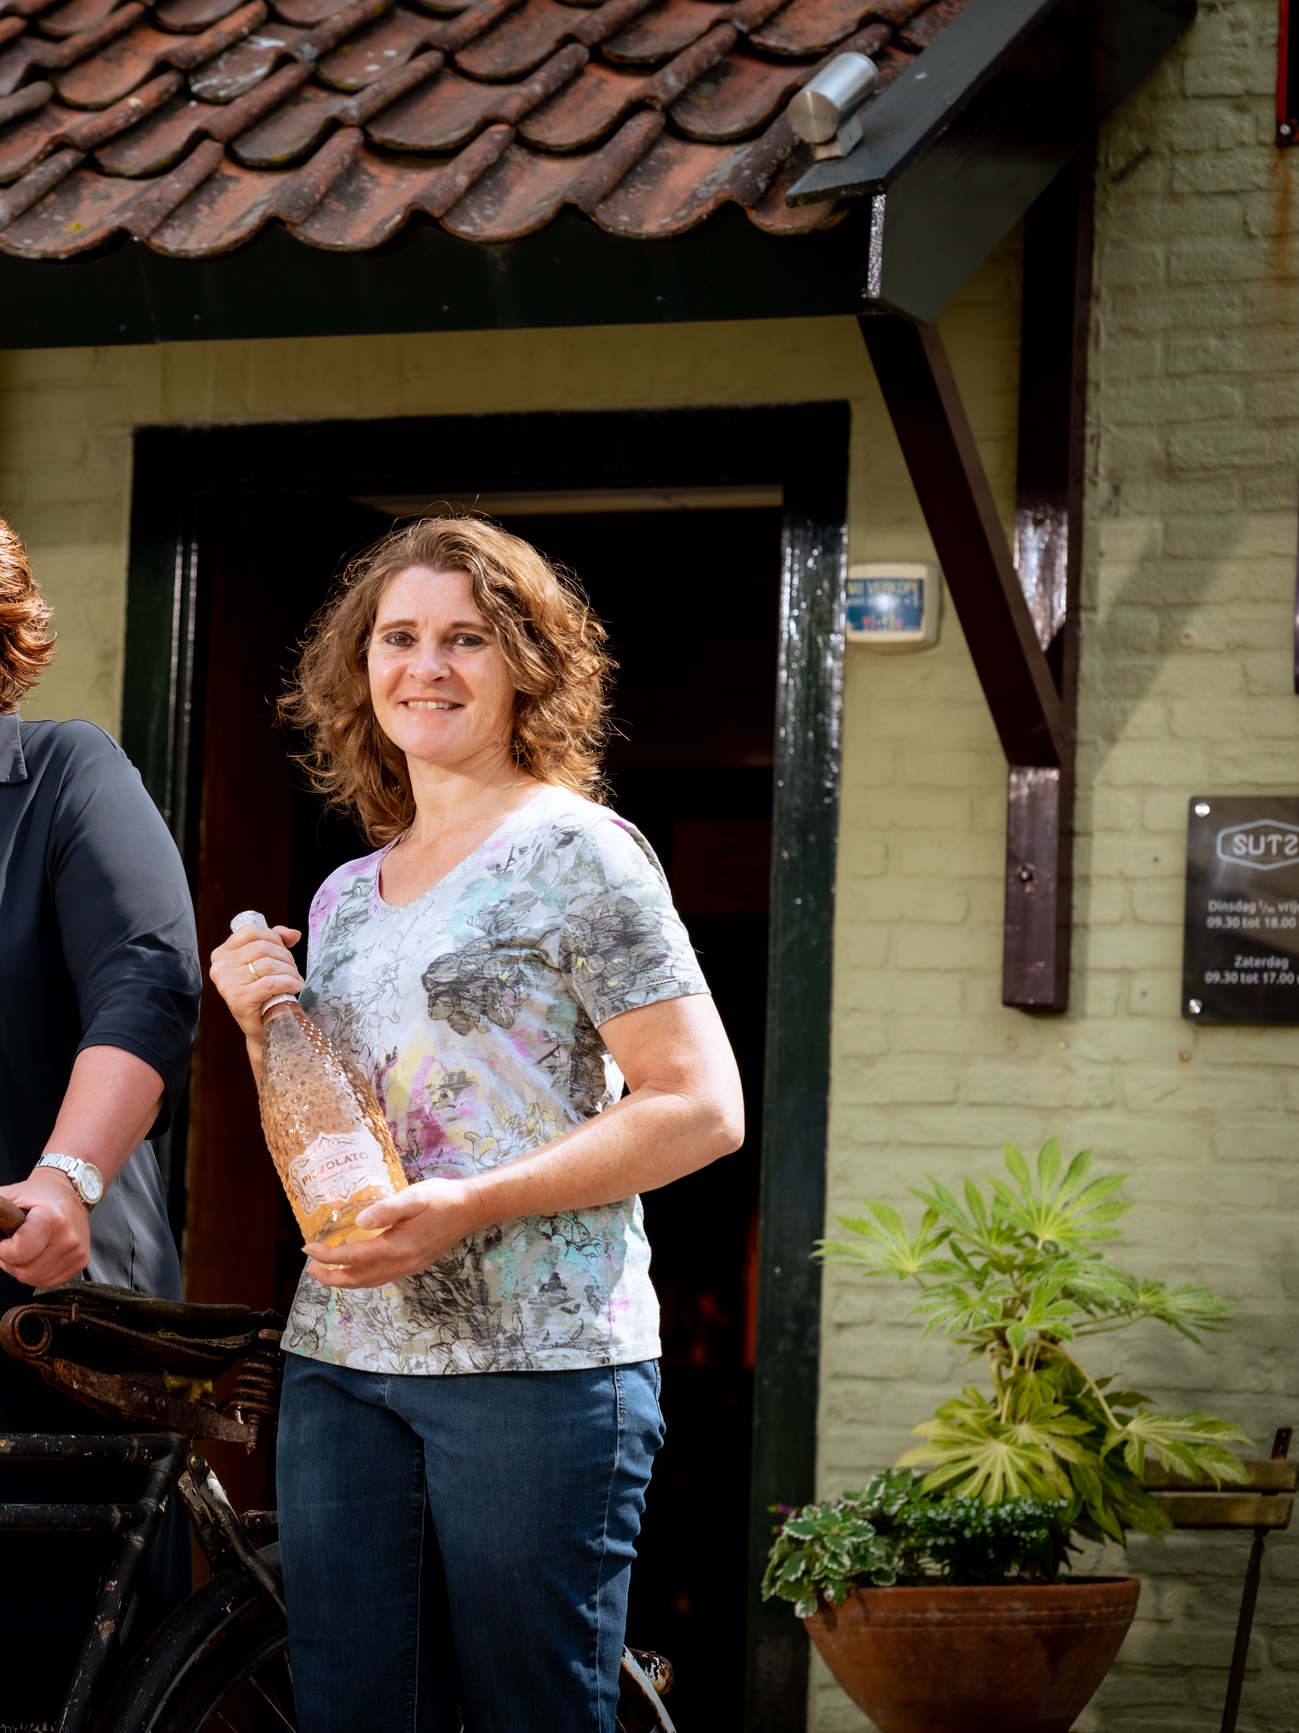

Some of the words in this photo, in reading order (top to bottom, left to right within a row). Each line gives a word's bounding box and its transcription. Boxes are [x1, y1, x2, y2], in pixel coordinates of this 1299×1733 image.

[1207, 899, 1257, 914] Dinsdag
[1206, 915, 1241, 929] 09.30
[1241, 916, 1262, 929] tot
[1264, 916, 1297, 929] 18.00
[1233, 954, 1289, 971] Zaterdag
[1204, 970, 1239, 984] 09.30
[1239, 971, 1260, 984] tot
[1262, 971, 1295, 985] 17.00
[301, 1151, 369, 1186] PIZZOLATO
